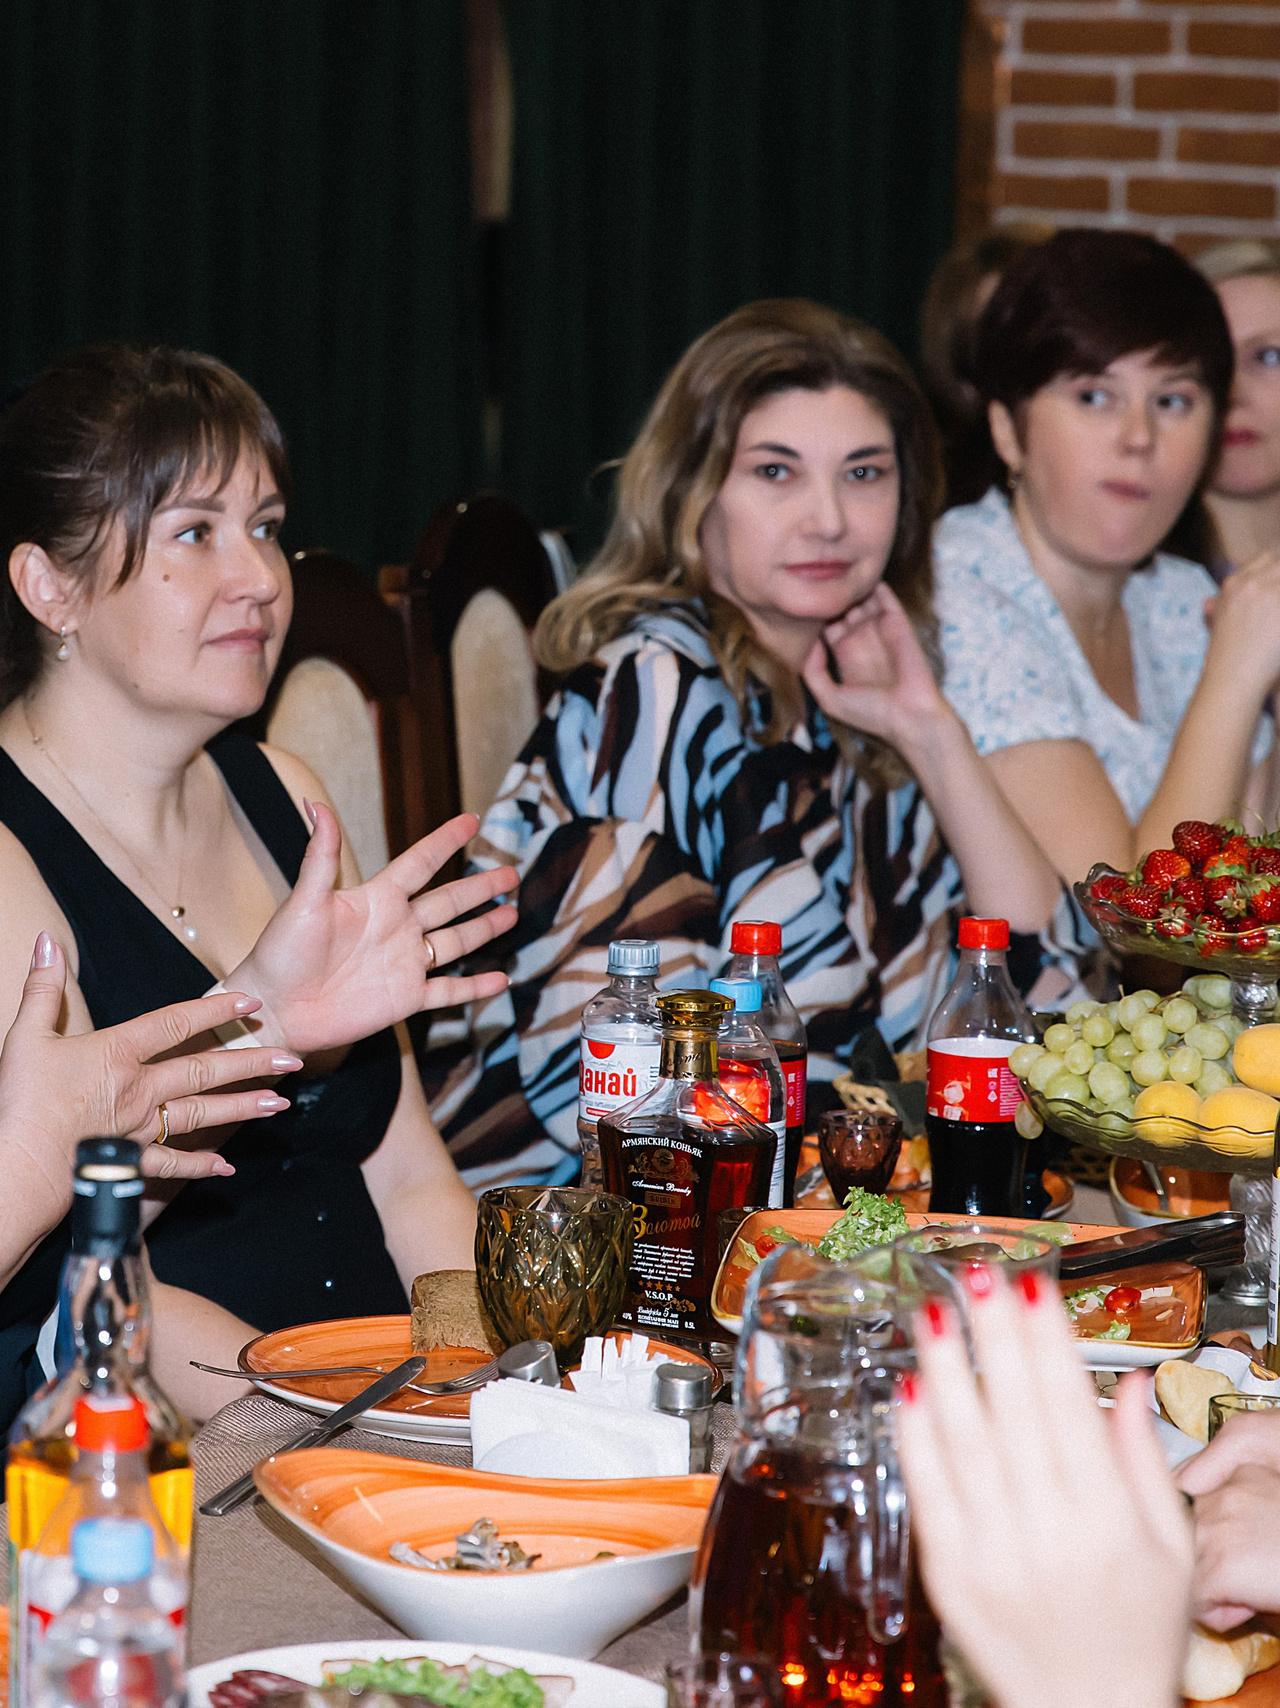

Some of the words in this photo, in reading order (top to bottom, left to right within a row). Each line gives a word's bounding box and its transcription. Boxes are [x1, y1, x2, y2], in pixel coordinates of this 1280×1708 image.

[621, 1137, 669, 1148] АРМЯНСКИЙ
[670, 1140, 703, 1158] КОНЬЯК
[666, 1183, 691, 1196] Brandy
